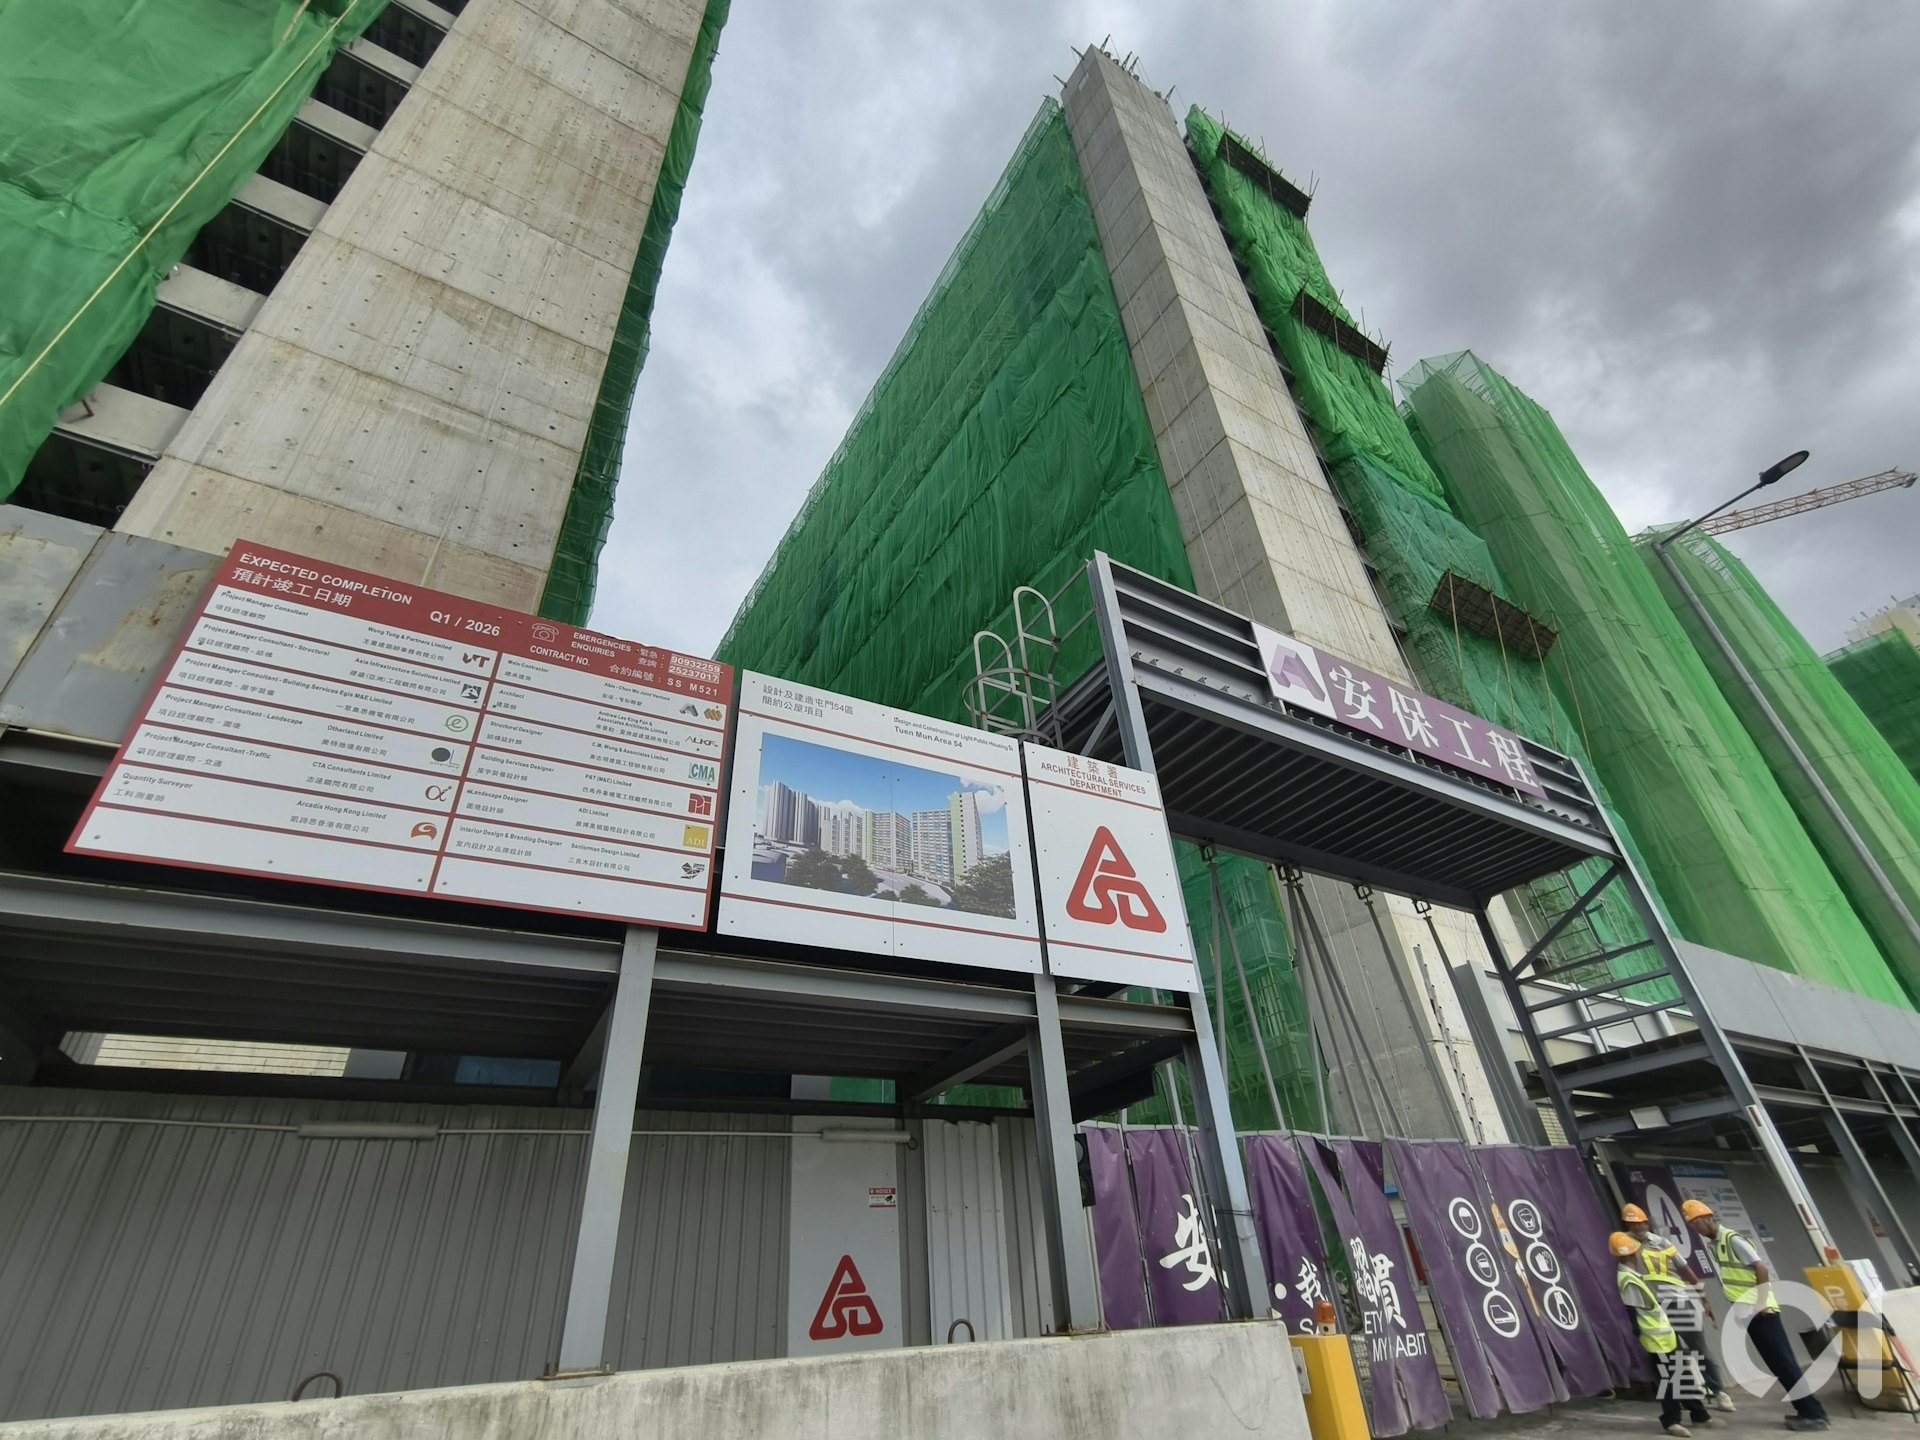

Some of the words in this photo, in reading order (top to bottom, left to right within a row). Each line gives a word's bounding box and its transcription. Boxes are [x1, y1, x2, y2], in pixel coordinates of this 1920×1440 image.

[229, 567, 353, 608] 預計竣工日期
[238, 553, 320, 581] EXPECTED
[319, 574, 412, 604] COMPLETION
[220, 592, 246, 602] Project
[245, 598, 274, 609] Manager
[273, 604, 308, 616] Consultant
[428, 609, 451, 625] Q1
[464, 619, 501, 636] 2026
[202, 624, 229, 634] Project
[227, 630, 258, 641] Manager
[257, 636, 294, 648] Consultant
[297, 645, 330, 656] Structural
[405, 635, 430, 645] Partners
[430, 641, 452, 650] Limited
[570, 640, 615, 657] ENQUIRIES
[573, 632, 631, 652] EMERGENCIES
[529, 645, 576, 663] CONTRACT
[576, 656, 590, 666] NO.
[670, 655, 720, 674] 90932259
[184, 658, 211, 668] Project
[210, 664, 241, 675] Manager
[241, 670, 278, 681] Consultant
[282, 678, 310, 689] Building
[310, 684, 338, 694] Services
[410, 670, 438, 680] Solutions
[439, 676, 460, 685] Limited
[669, 664, 718, 683] 25237017
[498, 689, 524, 698] Architect
[667, 677, 682, 687] SS
[689, 683, 717, 696] M521
[369, 696, 392, 705] Limited
[762, 684, 854, 715] 設計及建造屯門54區
[762, 696, 823, 718] 簡約公屋項目
[164, 694, 192, 704] Project
[191, 699, 223, 710] Manager
[223, 705, 262, 717] Consultant
[266, 714, 303, 725] Landscape
[326, 725, 359, 735] Otherland
[359, 731, 383, 740] Limited
[518, 727, 542, 736] Designer
[894, 717, 911, 727] Design
[912, 721, 922, 729] and
[923, 724, 954, 737] Construction
[961, 734, 973, 742] Light
[974, 736, 988, 746] Public
[989, 740, 1008, 752] Housing
[1329, 665, 1537, 789] 安保工程
[143, 731, 173, 742] Project
[172, 736, 206, 748] Manager
[205, 743, 245, 754] Consultant
[894, 726, 914, 737] Tuen
[915, 731, 932, 741] Mun
[934, 736, 952, 746] Area
[953, 740, 963, 748] 54
[326, 764, 366, 775] Consultants
[367, 771, 391, 780] Limited
[480, 754, 504, 763] Building
[505, 759, 529, 767] Services
[529, 764, 554, 773] Designer
[690, 763, 716, 781] CMA
[1067, 755, 1118, 779] 建築署
[120, 772, 157, 784] Quantity
[156, 778, 193, 789] Surveyor
[613, 779, 631, 787] Limited
[1041, 762, 1108, 785] ARCHITECTURAL
[1109, 779, 1146, 795] SERVICES
[1069, 778, 1122, 798] DEPARTMENT
[470, 789, 501, 799] Landscape
[502, 794, 528, 804] Designer
[295, 800, 323, 809] Arcadis
[323, 804, 342, 813] Hong
[342, 807, 361, 816] Kong
[361, 811, 386, 819] Limited
[589, 809, 608, 817] Limited
[459, 826, 482, 834] Interior
[482, 829, 503, 838] Design
[509, 834, 536, 843] Branding
[536, 838, 562, 847] Designer
[686, 836, 704, 846] ADI
[600, 847, 619, 856] Design
[620, 850, 639, 858] Limited
